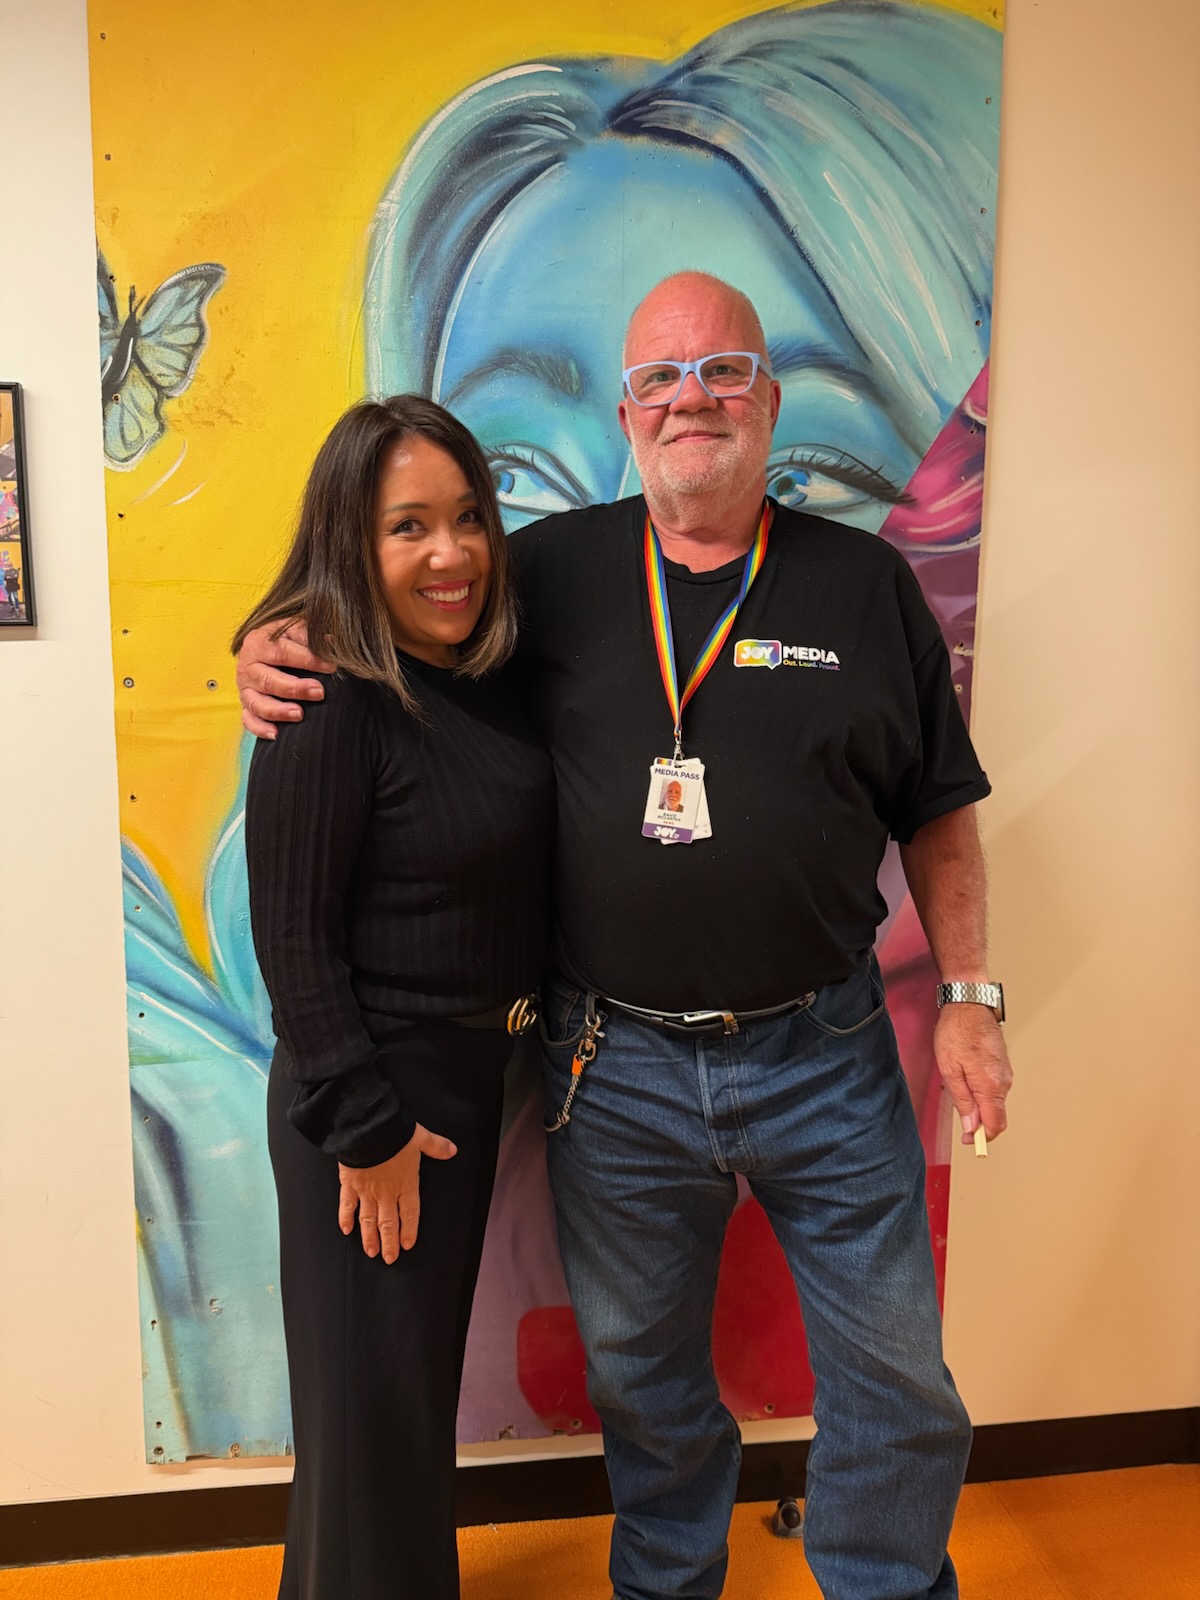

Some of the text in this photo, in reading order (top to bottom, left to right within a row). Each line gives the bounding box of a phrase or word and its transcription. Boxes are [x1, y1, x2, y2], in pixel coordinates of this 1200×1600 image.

[741, 646, 840, 664] JOY MEDIA
[783, 659, 841, 671] Out. Loud. Proud.
[654, 767, 700, 780] MEDIA PASS
